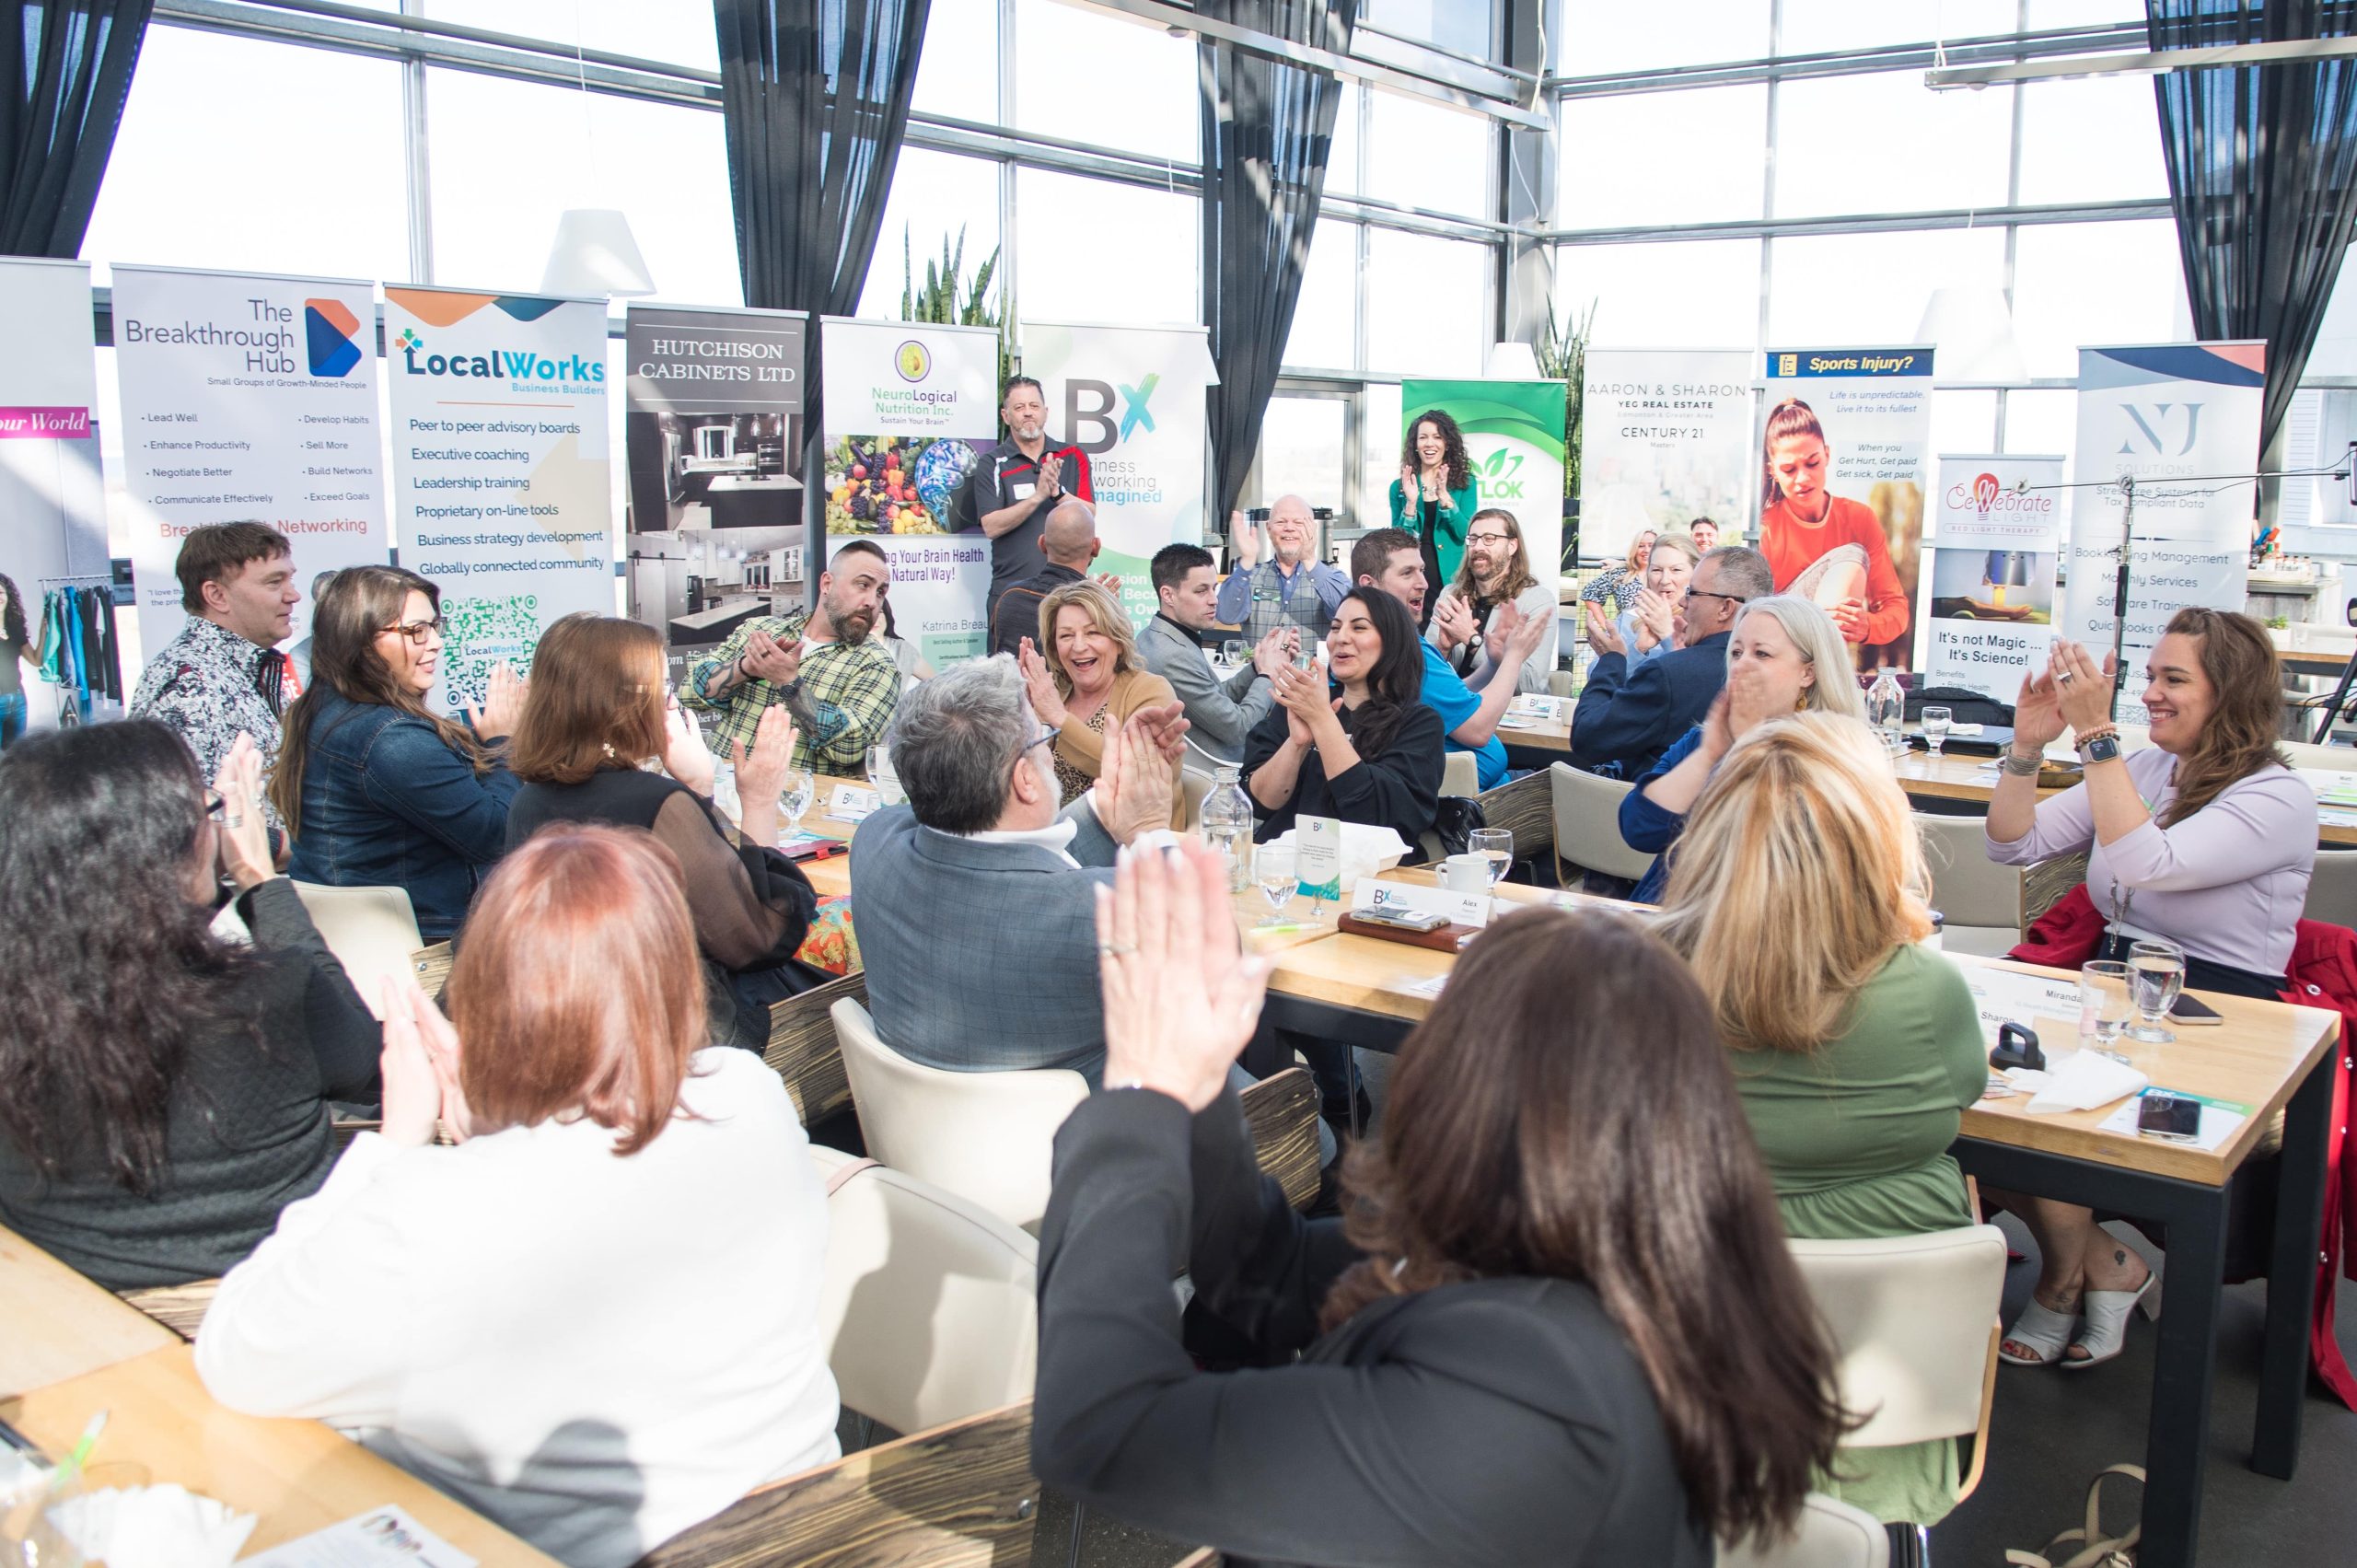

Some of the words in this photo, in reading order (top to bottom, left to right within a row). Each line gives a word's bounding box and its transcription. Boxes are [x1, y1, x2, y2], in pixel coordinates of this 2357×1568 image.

[248, 299, 292, 322] The
[125, 319, 294, 354] Breakthrough
[652, 339, 784, 360] HUTCHISON
[247, 351, 296, 373] Hub
[406, 348, 605, 382] LocalWorks
[1810, 357, 1858, 373] Sports
[1861, 356, 1914, 372] Injury?
[639, 363, 752, 382] CABINETS
[757, 366, 796, 383] LTD
[208, 377, 230, 386] Small
[234, 378, 264, 387] Groups
[266, 378, 275, 387] of
[277, 379, 338, 389] Growth-Minded
[340, 380, 366, 389] People
[512, 383, 560, 394] Business
[563, 385, 605, 395] Builders
[872, 387, 957, 405] NeuroLogical
[1587, 384, 1648, 396] AARON
[1655, 384, 1665, 396] &
[1672, 384, 1746, 397] SHARON
[1830, 391, 1847, 400] Life
[1859, 390, 1926, 401] unpredictable,
[876, 402, 929, 415] Nutrition
[933, 405, 954, 416] Inc.
[29, 412, 86, 431] World
[148, 413, 173, 422] Lead
[175, 413, 198, 422] Well
[304, 415, 342, 424] Develop
[343, 416, 370, 424] Habits
[410, 419, 438, 432] Peer
[441, 420, 454, 432] to
[456, 422, 485, 435] peer
[487, 420, 537, 436] advisory
[540, 422, 581, 435] boards
[1621, 427, 1688, 438] CENTURY
[1692, 428, 1704, 439] 21
[2116, 403, 2206, 456] NJ
[150, 441, 192, 450] Enhance
[195, 441, 250, 451] Productivity
[306, 441, 324, 450] Sell
[326, 441, 349, 450] More
[412, 448, 472, 460] Executive
[474, 449, 529, 464] coaching
[1856, 457, 1877, 465] Hurt,
[1880, 457, 1896, 465] Get
[1897, 457, 1917, 467] paid
[308, 467, 331, 476] Build
[333, 467, 373, 476] Networks
[1092, 458, 1136, 473] iness
[2115, 464, 2195, 476] SOLUTIONS
[152, 468, 201, 479] Negotiate
[203, 468, 232, 477] Better
[1854, 470, 1874, 479] sick,
[1894, 470, 1914, 480] paid
[413, 477, 482, 491] Leadership
[485, 477, 530, 491] training
[1094, 474, 1156, 493] working
[155, 495, 222, 505] Communicate
[224, 494, 273, 504] Effectively
[310, 493, 344, 502] Exceed
[345, 493, 370, 501] Goals
[1095, 489, 1162, 506] magined
[2154, 487, 2199, 498] Systems
[2202, 488, 2215, 498] for
[2105, 497, 2122, 506] Tax
[2131, 498, 2176, 508] ompliant
[2179, 499, 2205, 508] Data
[416, 505, 483, 519] Proprietary
[486, 505, 528, 517] on-line
[530, 504, 559, 516] tools
[1993, 513, 2049, 523] LIGHT
[278, 518, 367, 535] Networking
[418, 534, 471, 546] Business
[474, 534, 524, 548] strategy
[527, 531, 604, 545] development
[900, 550, 922, 563] Your
[924, 549, 950, 563] Brain
[952, 548, 984, 563] Health
[2152, 552, 2229, 565] Management
[420, 562, 470, 576] Globally
[473, 559, 538, 572] connected
[540, 557, 604, 572] community
[892, 567, 929, 582] Natural
[931, 567, 955, 584] Way!
[2102, 573, 2146, 587] Mohly
[2150, 575, 2199, 588] Services
[2096, 597, 2148, 610] Sofare
[922, 620, 958, 632] Katrina
[1939, 632, 1958, 644] It's
[1962, 634, 1983, 645] not
[1986, 634, 2026, 650] Magic
[465, 645, 522, 656] LocalWorks
[1949, 649, 1968, 661] It's
[1972, 650, 2029, 666] Science!
[1936, 669, 1966, 679] Benefits
[1947, 681, 1967, 690] Brain
[1968, 682, 1991, 691] Health
[1462, 899, 1478, 907] Alex
[2046, 989, 2084, 1004] Miranda
[1981, 1011, 2015, 1025] Sharon
